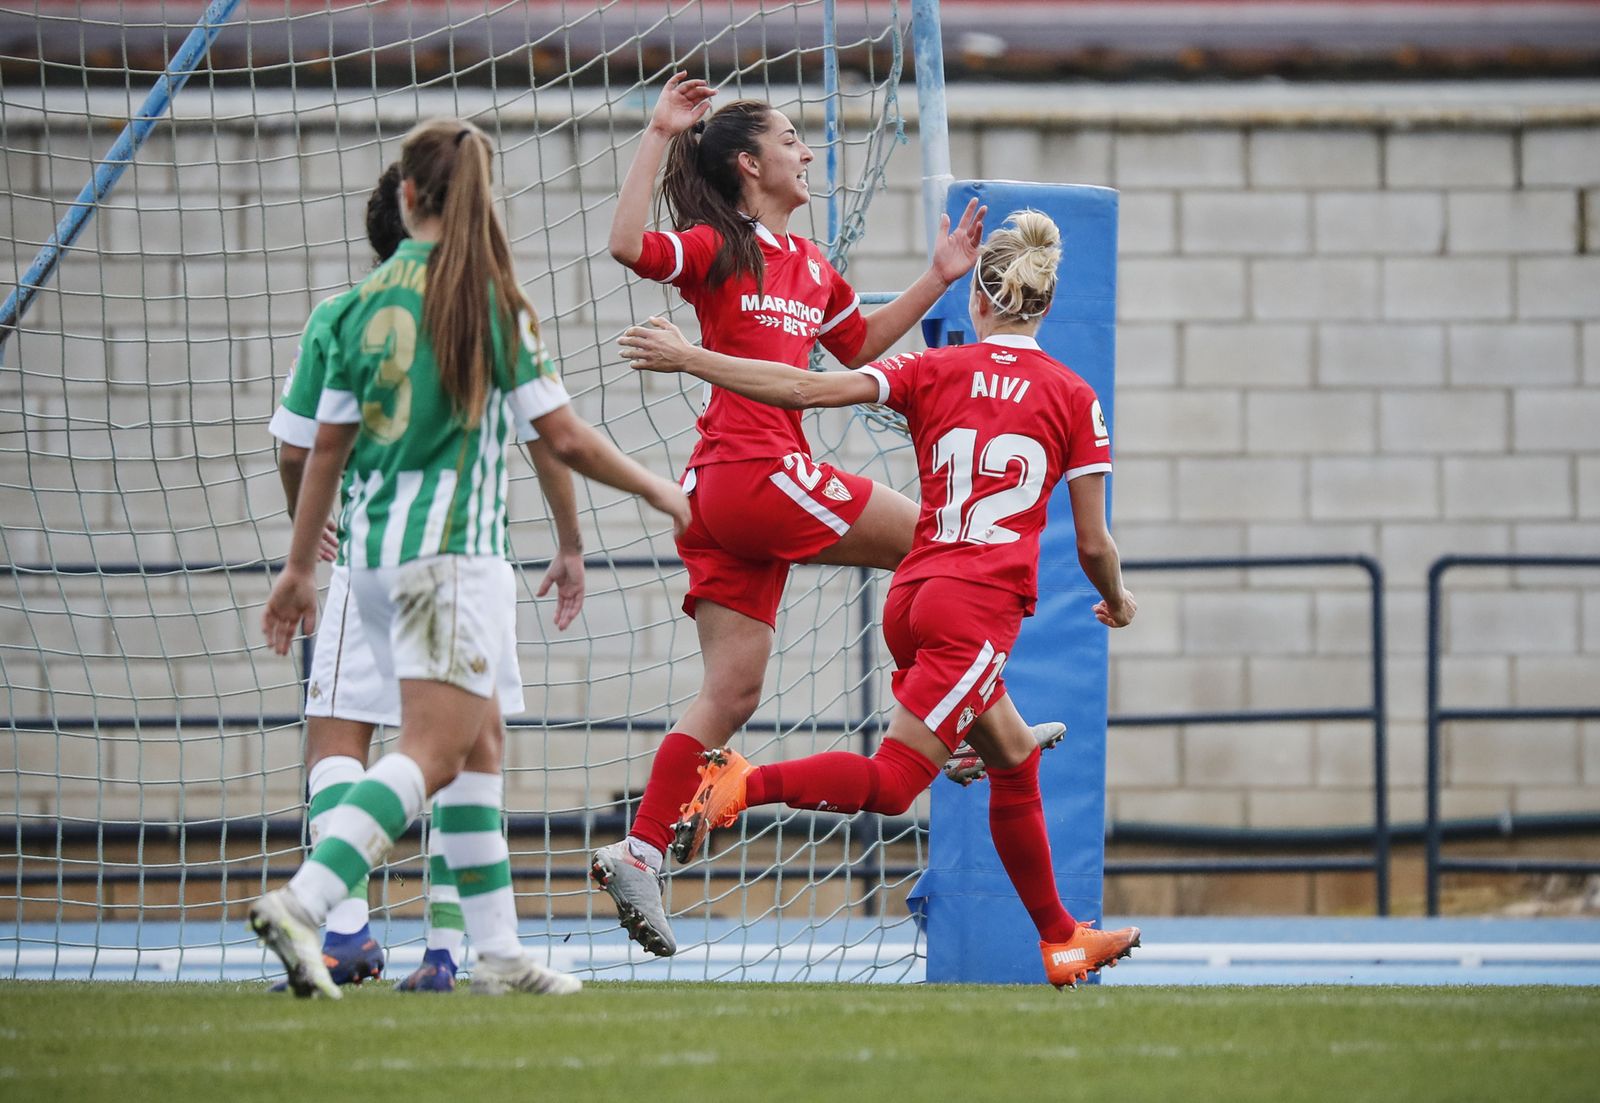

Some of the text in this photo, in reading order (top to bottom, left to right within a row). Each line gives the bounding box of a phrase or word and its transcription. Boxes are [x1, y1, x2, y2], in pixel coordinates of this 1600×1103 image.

[741, 294, 824, 324] MARATHO
[783, 315, 808, 336] BET
[361, 305, 417, 446] 3
[970, 371, 1031, 404] AIVI
[783, 452, 823, 491] 2
[932, 427, 1048, 545] 12
